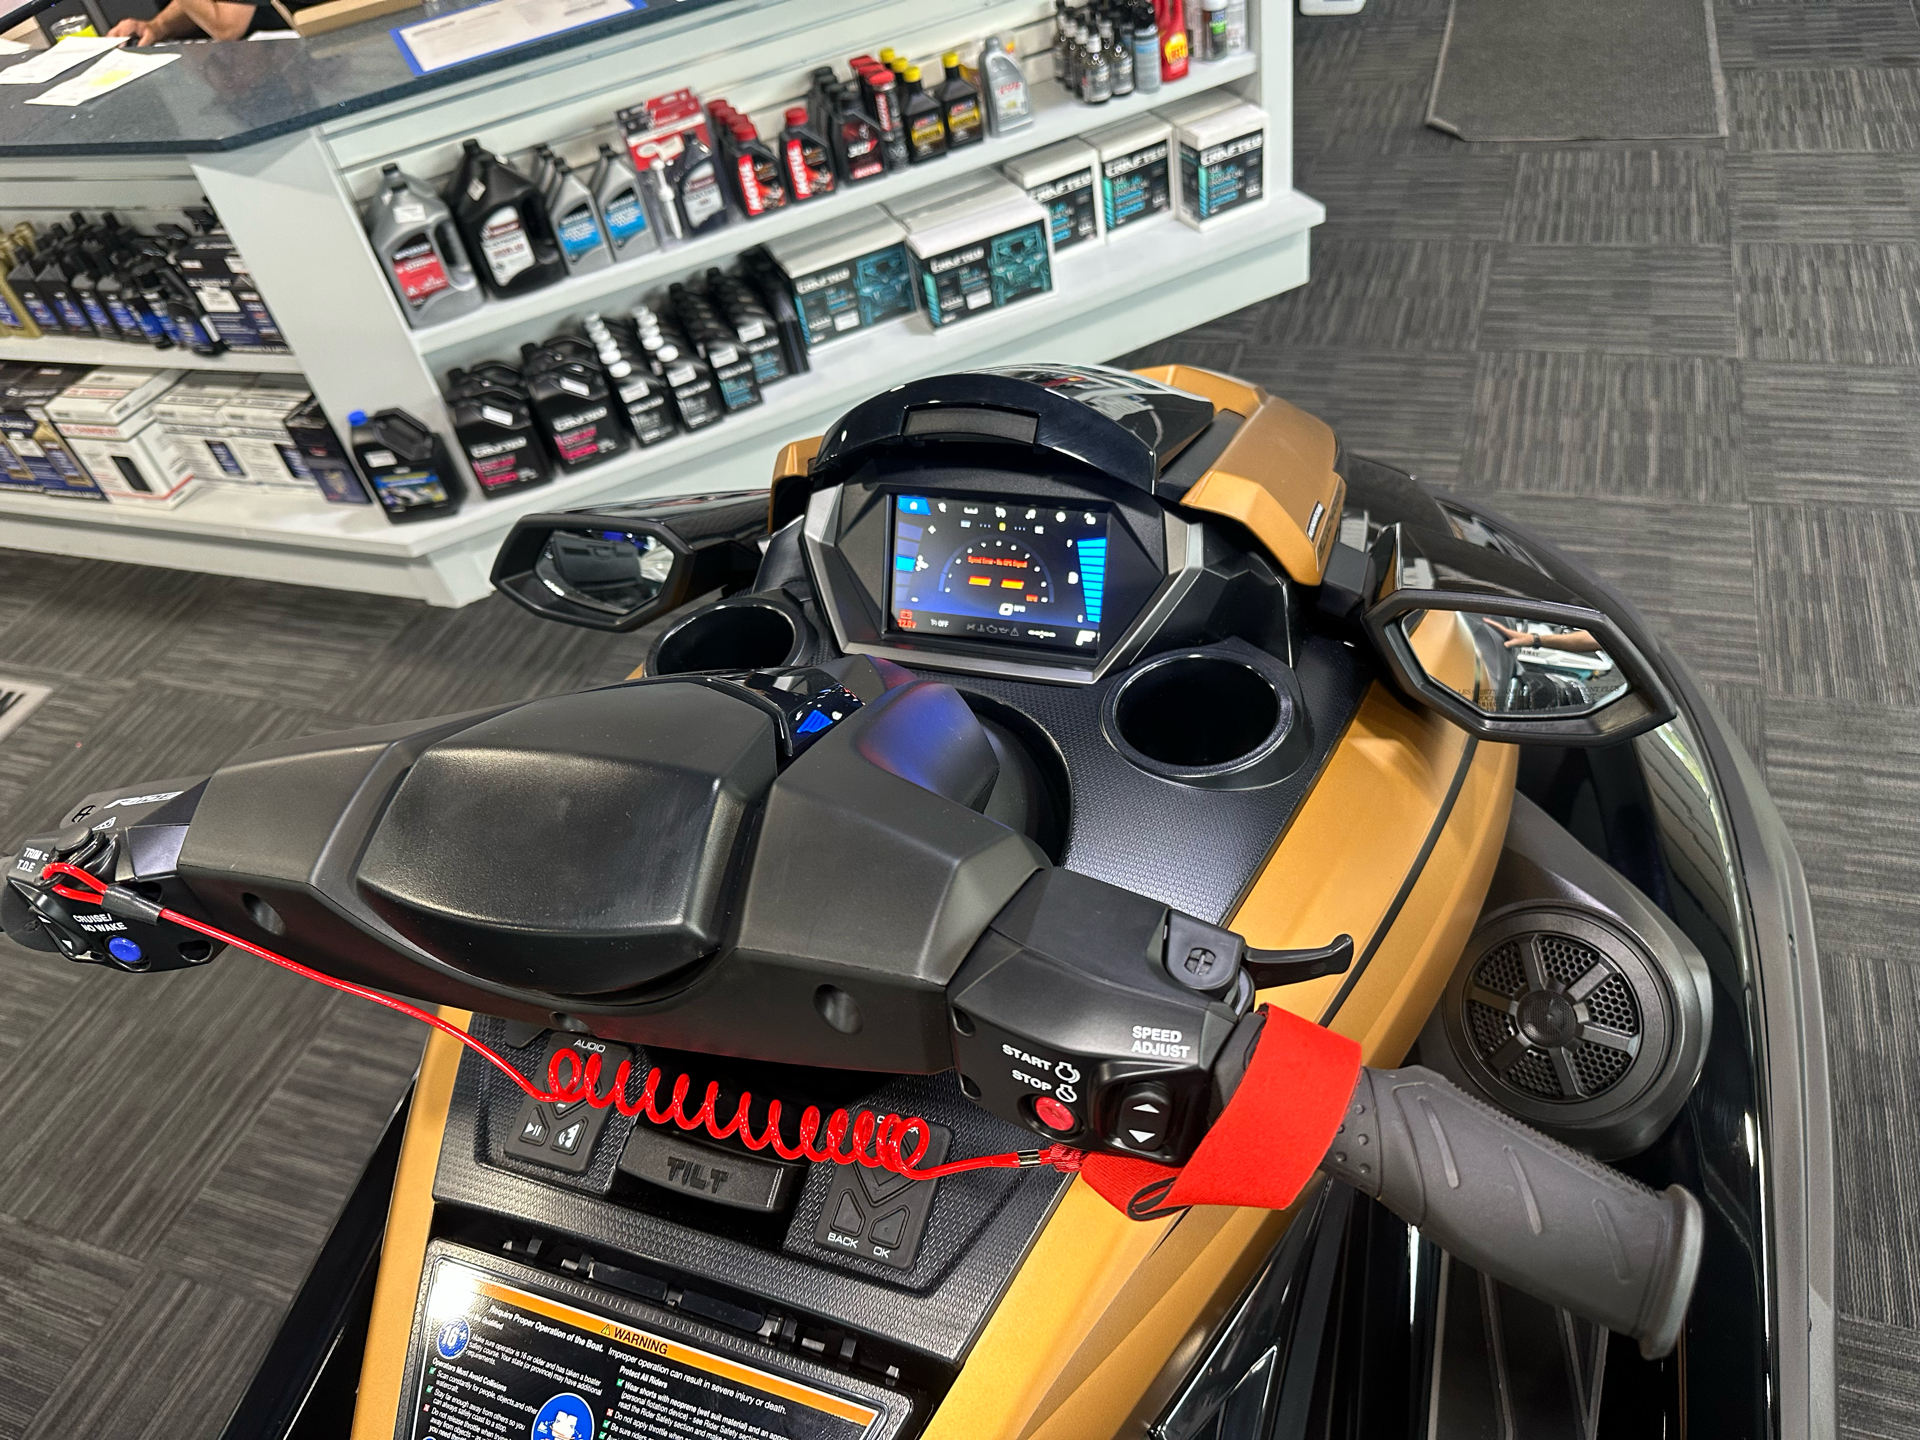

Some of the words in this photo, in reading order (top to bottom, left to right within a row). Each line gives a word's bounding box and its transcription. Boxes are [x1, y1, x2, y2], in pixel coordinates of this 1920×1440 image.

[937, 620, 949, 628] OFF
[72, 913, 113, 925] CRUISE/
[80, 922, 96, 933] NO
[95, 921, 128, 933] WAKE
[1132, 1025, 1183, 1044] SPEED
[573, 1038, 607, 1053] AUDIO
[1131, 1039, 1191, 1059] ADJUST
[1002, 1043, 1052, 1072] START
[1011, 1069, 1052, 1092] STOP
[667, 1155, 730, 1195] TILT
[827, 1231, 859, 1250] BACK
[872, 1246, 891, 1260] OK
[613, 1326, 669, 1356] WARNING
[513, 1313, 535, 1327] Proper
[535, 1321, 566, 1339] Operation
[566, 1333, 576, 1342] of
[574, 1335, 586, 1346] the
[585, 1339, 604, 1352] Boat.
[608, 1347, 638, 1363] Improper
[638, 1359, 669, 1374] operation
[669, 1370, 683, 1380] can
[683, 1374, 703, 1386] result
[703, 1379, 711, 1389] in
[711, 1384, 735, 1397] severe
[735, 1390, 755, 1405] injury
[755, 1398, 765, 1407] or
[764, 1401, 786, 1415] death.
[619, 1365, 641, 1379] Protect
[639, 1372, 650, 1382] All
[648, 1375, 668, 1389] Riders
